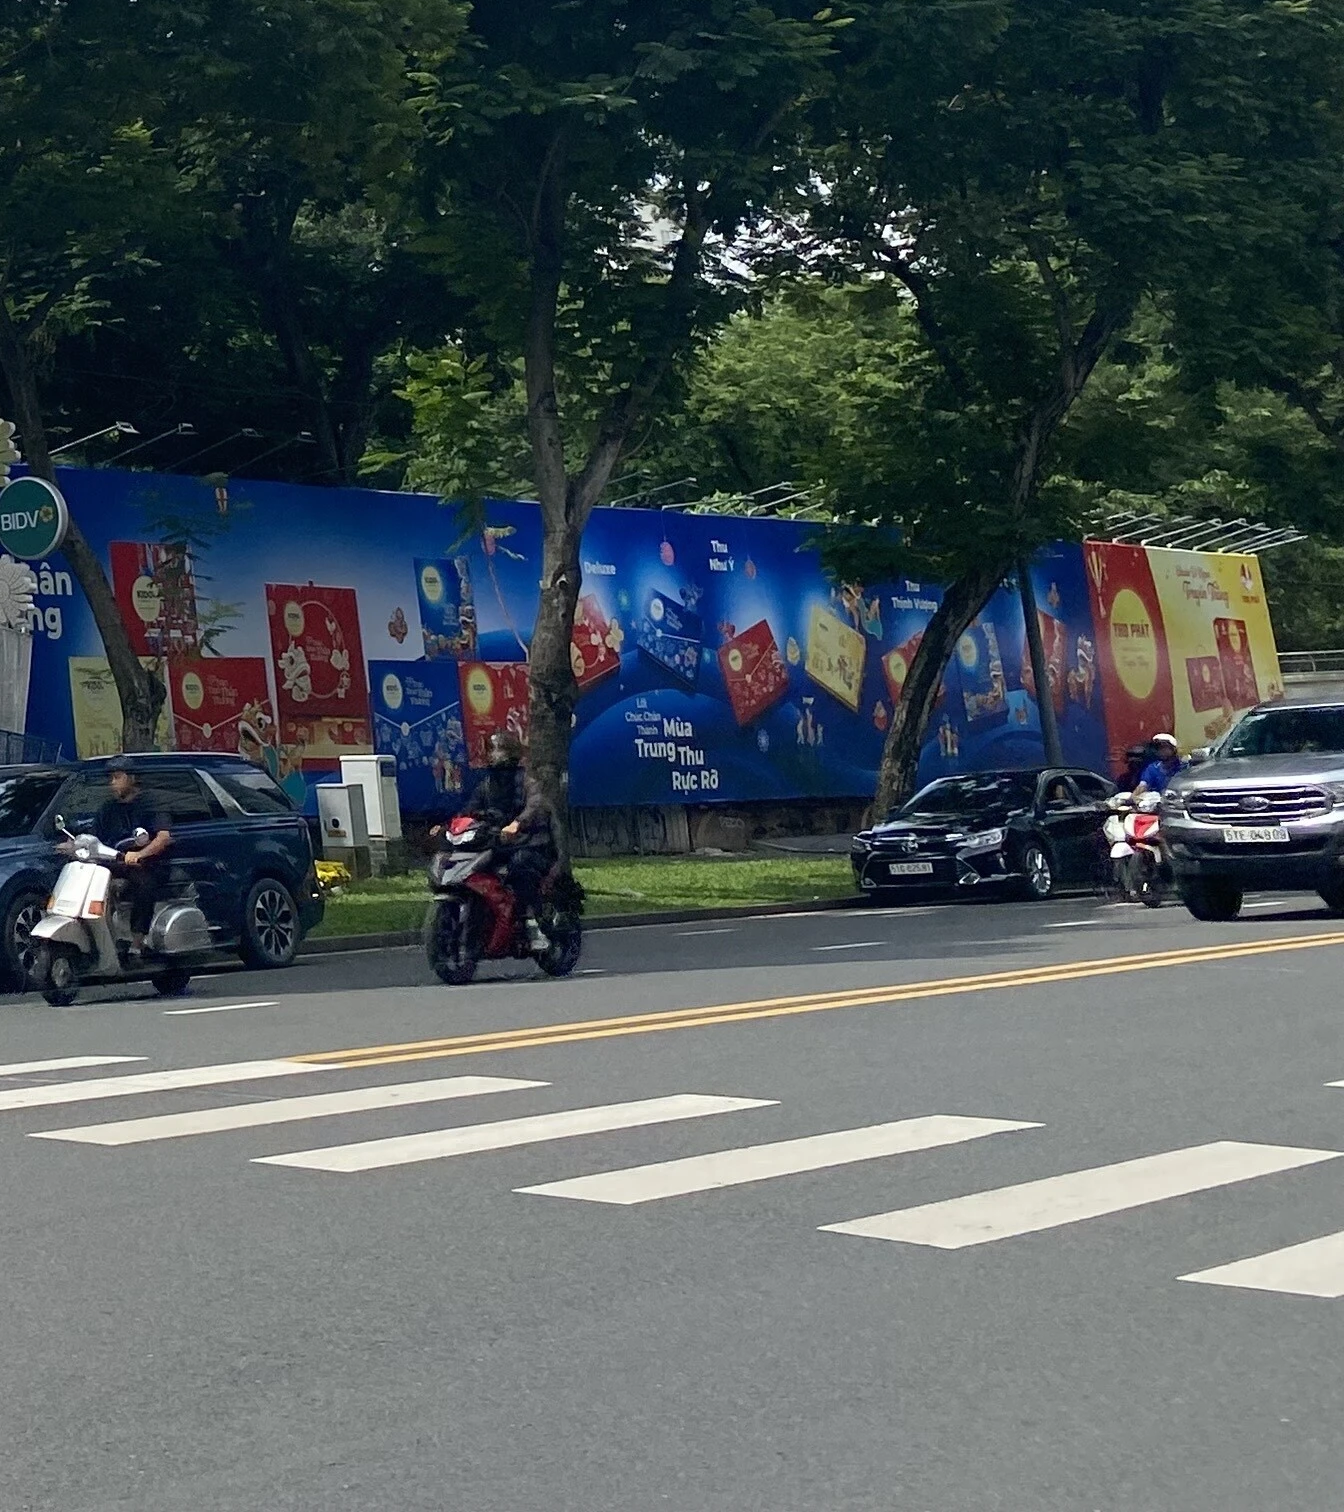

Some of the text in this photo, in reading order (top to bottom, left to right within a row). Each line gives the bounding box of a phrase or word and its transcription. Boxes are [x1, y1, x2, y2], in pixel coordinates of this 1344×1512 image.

[0, 510, 40, 531] BIDV
[710, 540, 728, 554] Thu
[583, 561, 616, 575] Deluxe
[727, 556, 734, 571] Ý
[663, 717, 693, 737] Mùa
[635, 739, 704, 766] Trung Thu
[672, 769, 719, 795] Rực Rỡ
